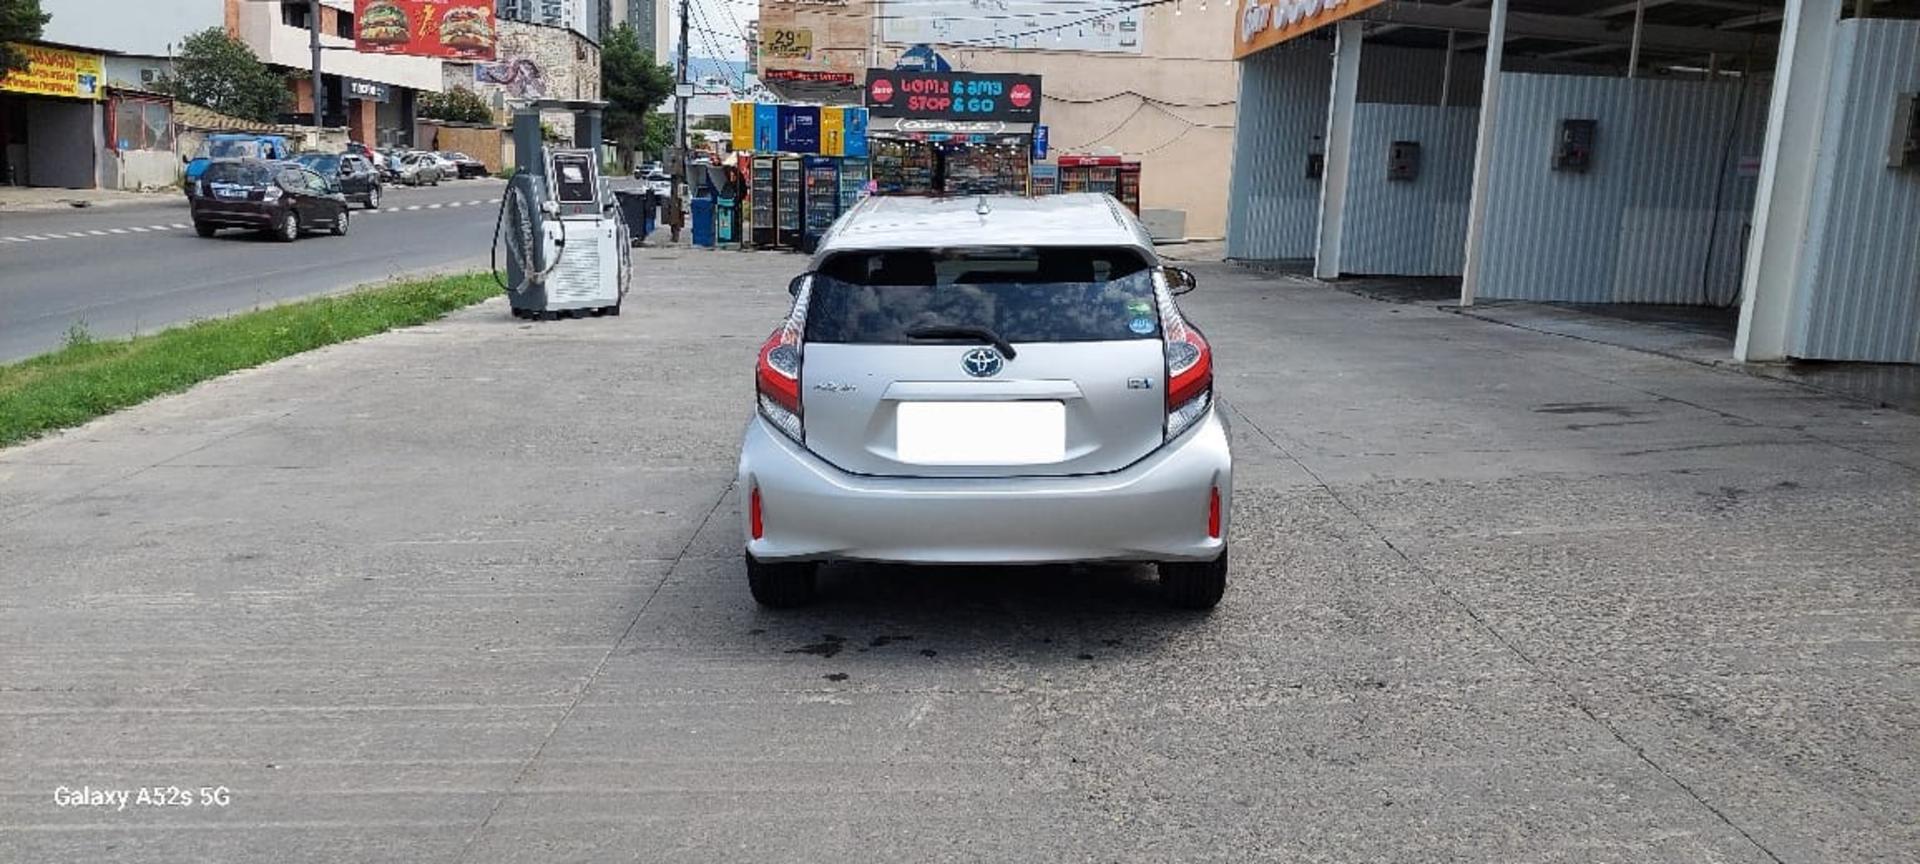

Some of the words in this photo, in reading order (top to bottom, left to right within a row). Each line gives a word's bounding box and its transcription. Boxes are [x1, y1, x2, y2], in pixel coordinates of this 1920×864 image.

[775, 30, 795, 46] 29
[908, 96, 951, 111] STOP
[953, 97, 965, 112] &
[967, 98, 995, 112] GO
